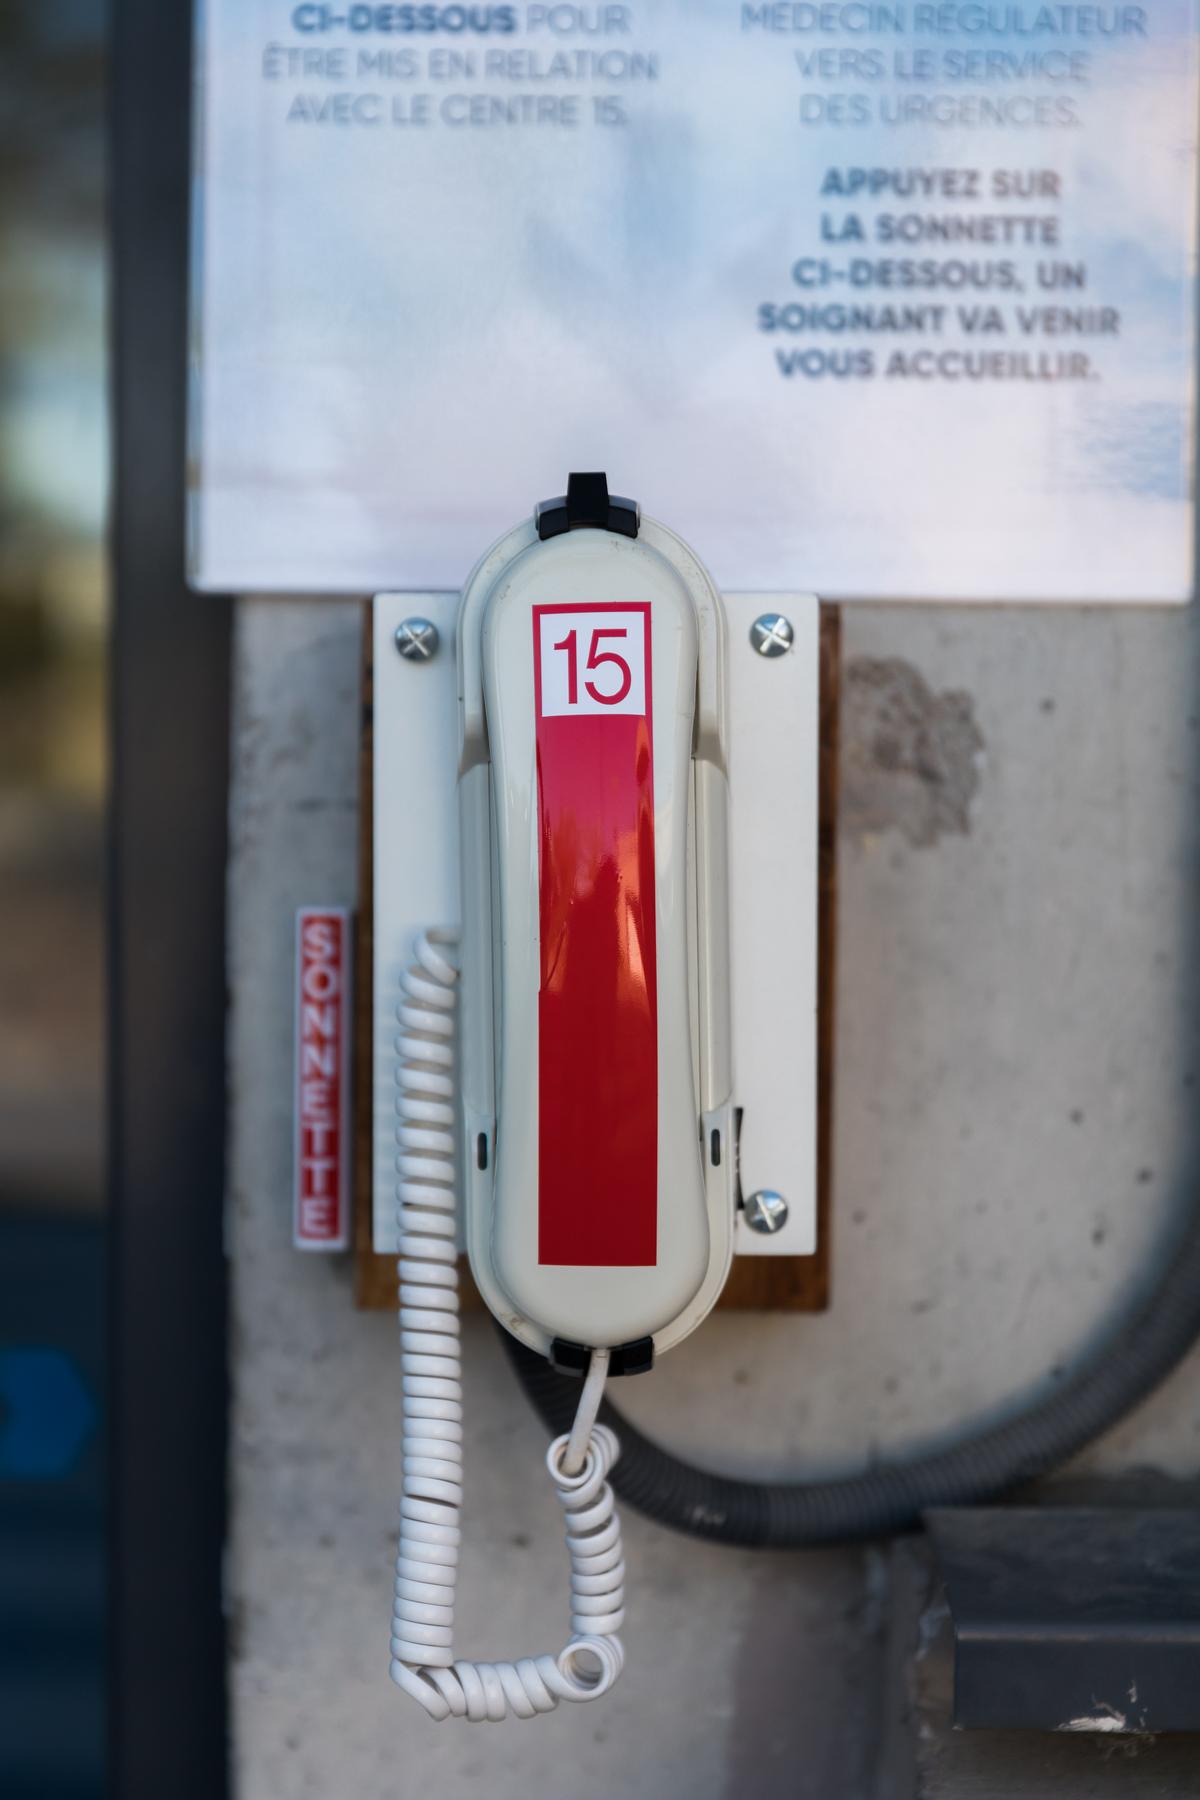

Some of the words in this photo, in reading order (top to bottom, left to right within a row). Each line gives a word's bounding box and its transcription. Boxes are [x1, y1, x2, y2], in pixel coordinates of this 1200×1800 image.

[291, 4, 516, 33] CI-DESSOUS
[525, 4, 632, 34] POUR
[261, 41, 346, 80] ÊTRE
[356, 48, 417, 80] MIS
[427, 48, 475, 80] EN
[484, 49, 659, 81] RELATION
[794, 49, 885, 79] VERS
[893, 49, 935, 80] LE
[942, 50, 1091, 82] SERVICE
[286, 94, 383, 126] AVEC
[391, 94, 430, 126] LE
[440, 94, 580, 126] CENTRE
[800, 93, 872, 125] DES
[880, 95, 1081, 128] URGENCES.
[820, 168, 980, 198] APPUYEZ
[992, 169, 1061, 198] SUR
[820, 214, 864, 242] LA
[877, 214, 1060, 244] SONNETTE
[792, 259, 1025, 292] CI-DESSOUS,
[1037, 262, 1086, 290] UN
[758, 304, 947, 334] SOIGNANT
[957, 306, 1005, 335] VA
[1016, 307, 1120, 336] VENIR
[775, 350, 874, 378] VOUS
[886, 352, 1101, 382] ACCUEILLIR.
[554, 628, 631, 705] 15
[301, 922, 338, 1234] SONNETTE
